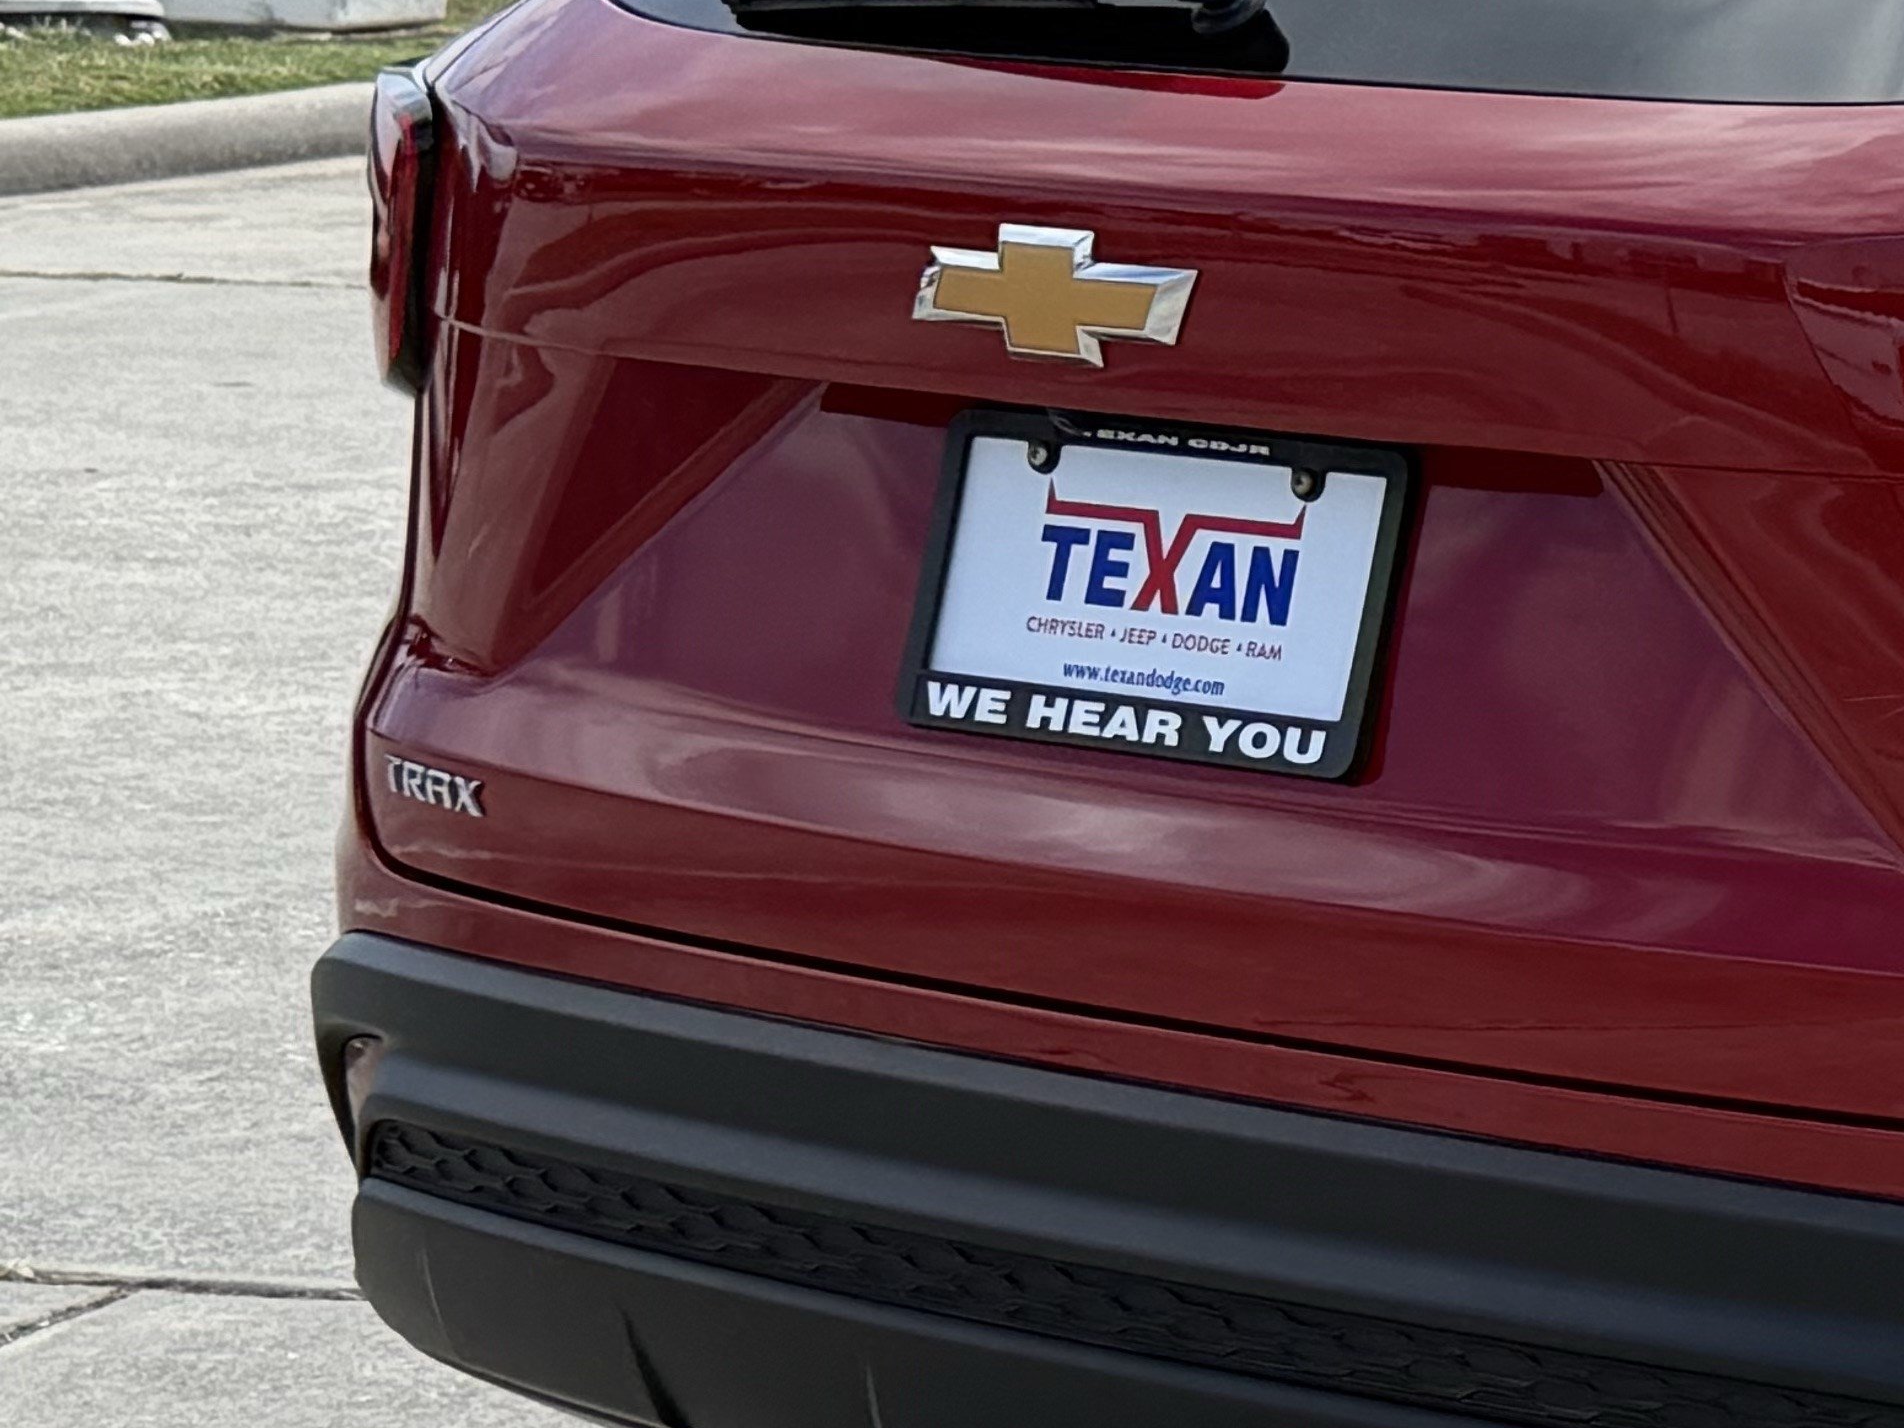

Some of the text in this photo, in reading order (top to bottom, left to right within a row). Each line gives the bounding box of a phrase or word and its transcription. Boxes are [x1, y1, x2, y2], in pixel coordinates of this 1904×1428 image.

[1081, 427, 1179, 447] EXAN
[1041, 479, 1306, 627] TEXAN
[1026, 615, 1283, 662] CHRYSLER JEEP DODGE RAM
[1062, 662, 1226, 696] www.texandodge.com
[926, 680, 1328, 765] WE HEAR YOU
[384, 754, 485, 818] TRAX
